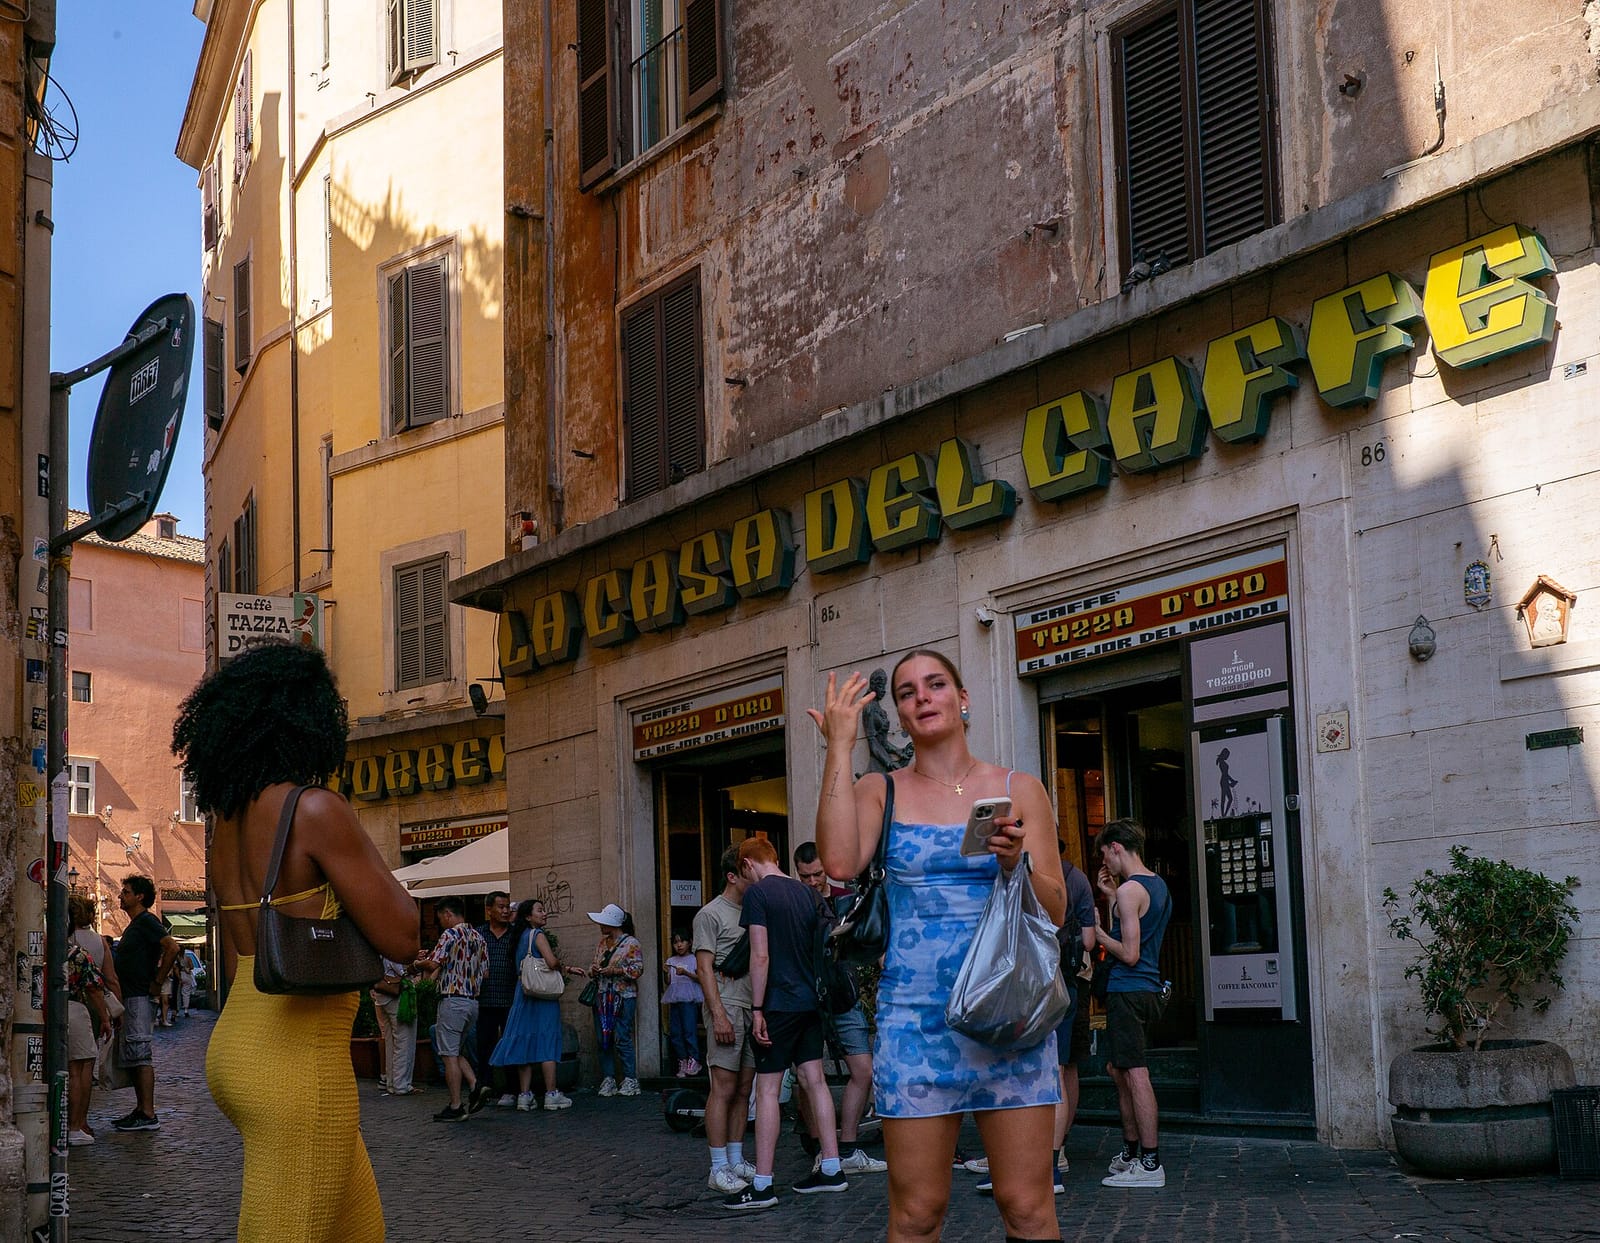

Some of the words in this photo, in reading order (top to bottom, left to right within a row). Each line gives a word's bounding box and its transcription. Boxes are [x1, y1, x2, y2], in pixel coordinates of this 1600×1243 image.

[498, 591, 570, 671] LA
[583, 508, 782, 642] CASA
[804, 436, 1000, 566] DEL
[1021, 222, 1535, 494] CAFFE
[1361, 442, 1386, 466] 86
[228, 614, 290, 634] TAZZA
[235, 599, 272, 611] caffè
[1032, 606, 1135, 649] TAZZA
[1160, 572, 1267, 617] D'ORO
[1027, 659, 1050, 672] EL
[1054, 636, 1132, 664] MEJOR
[1139, 624, 1182, 643] DEL
[1189, 600, 1279, 632] MUNDO
[640, 749, 653, 758] EL
[656, 737, 701, 754] MEJOR
[704, 730, 729, 743] DEL
[731, 718, 779, 737] MUNDO
[642, 714, 700, 741] TAZZA
[714, 696, 772, 723] D'ORO
[56, 1111, 69, 1147] Rapid
[51, 1175, 65, 1215] OCAS
